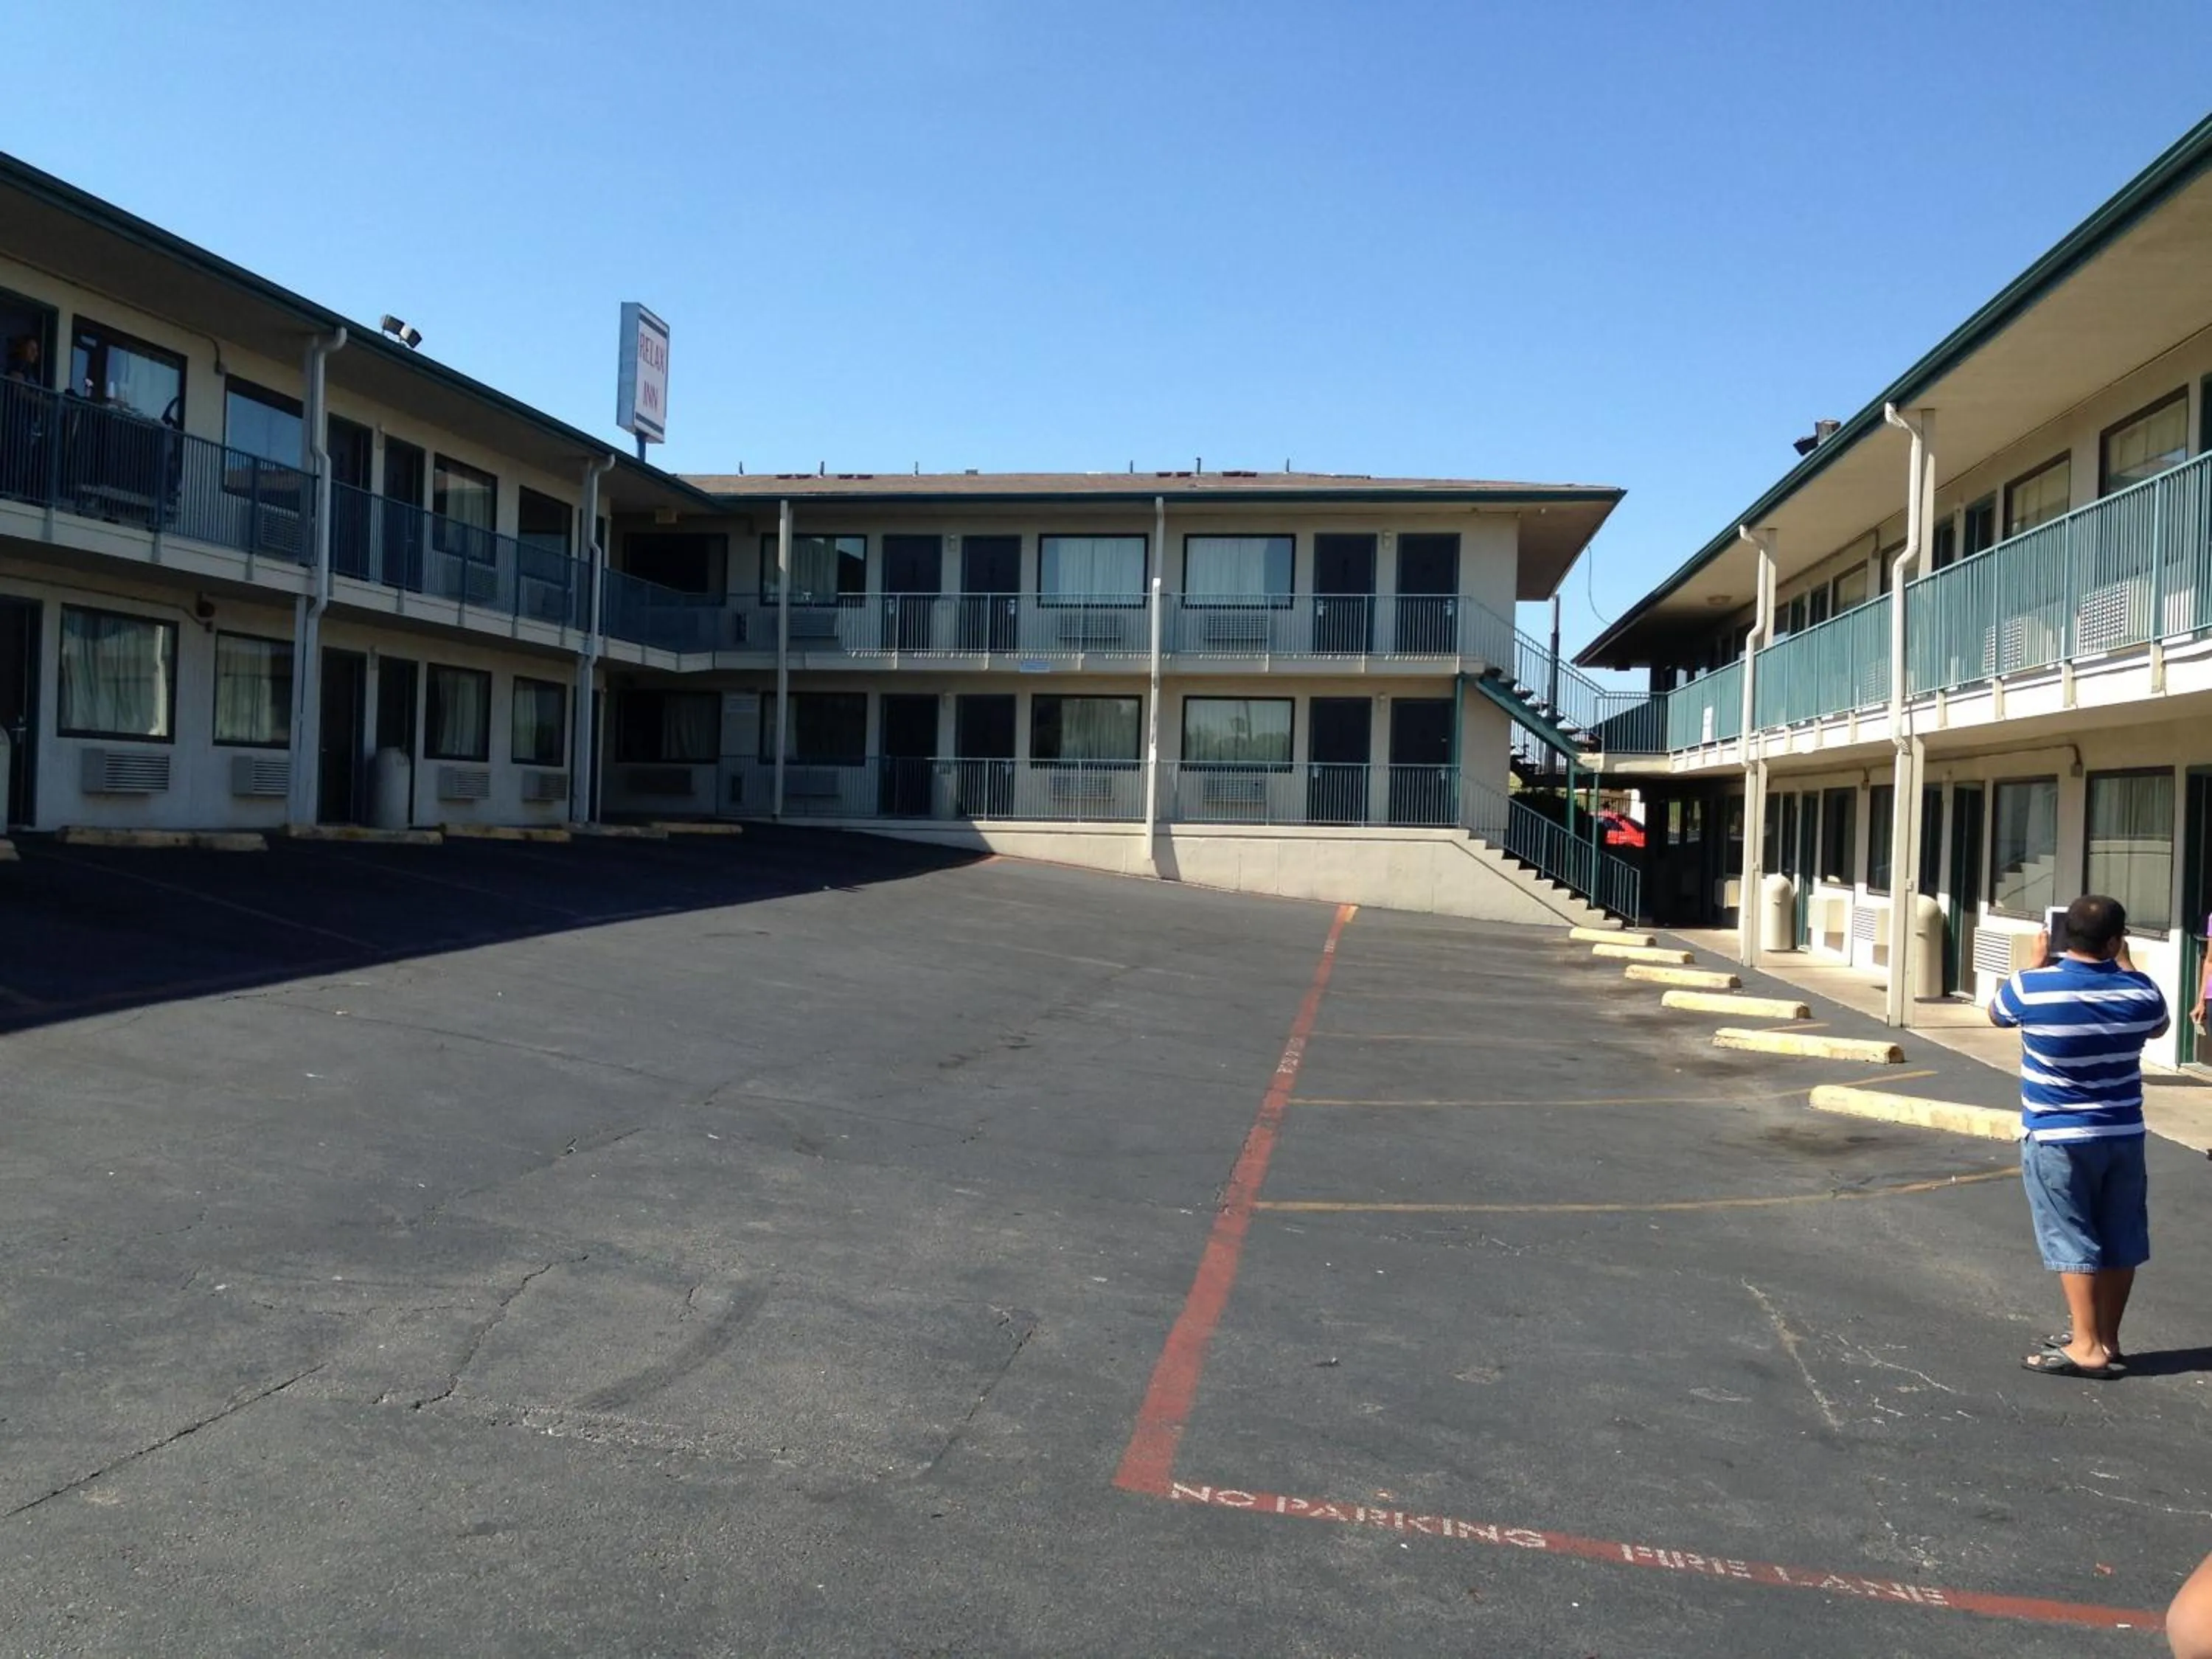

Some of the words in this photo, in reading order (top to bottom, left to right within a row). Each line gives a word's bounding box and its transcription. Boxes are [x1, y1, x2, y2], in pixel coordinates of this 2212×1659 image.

[639, 333, 664, 375] RELAX
[643, 380, 658, 412] INN
[1171, 1481, 1255, 1507] NO
[1276, 1495, 1546, 1548] PARKING
[1621, 1543, 1753, 1579] FIRE
[1773, 1565, 1949, 1606] LANE
